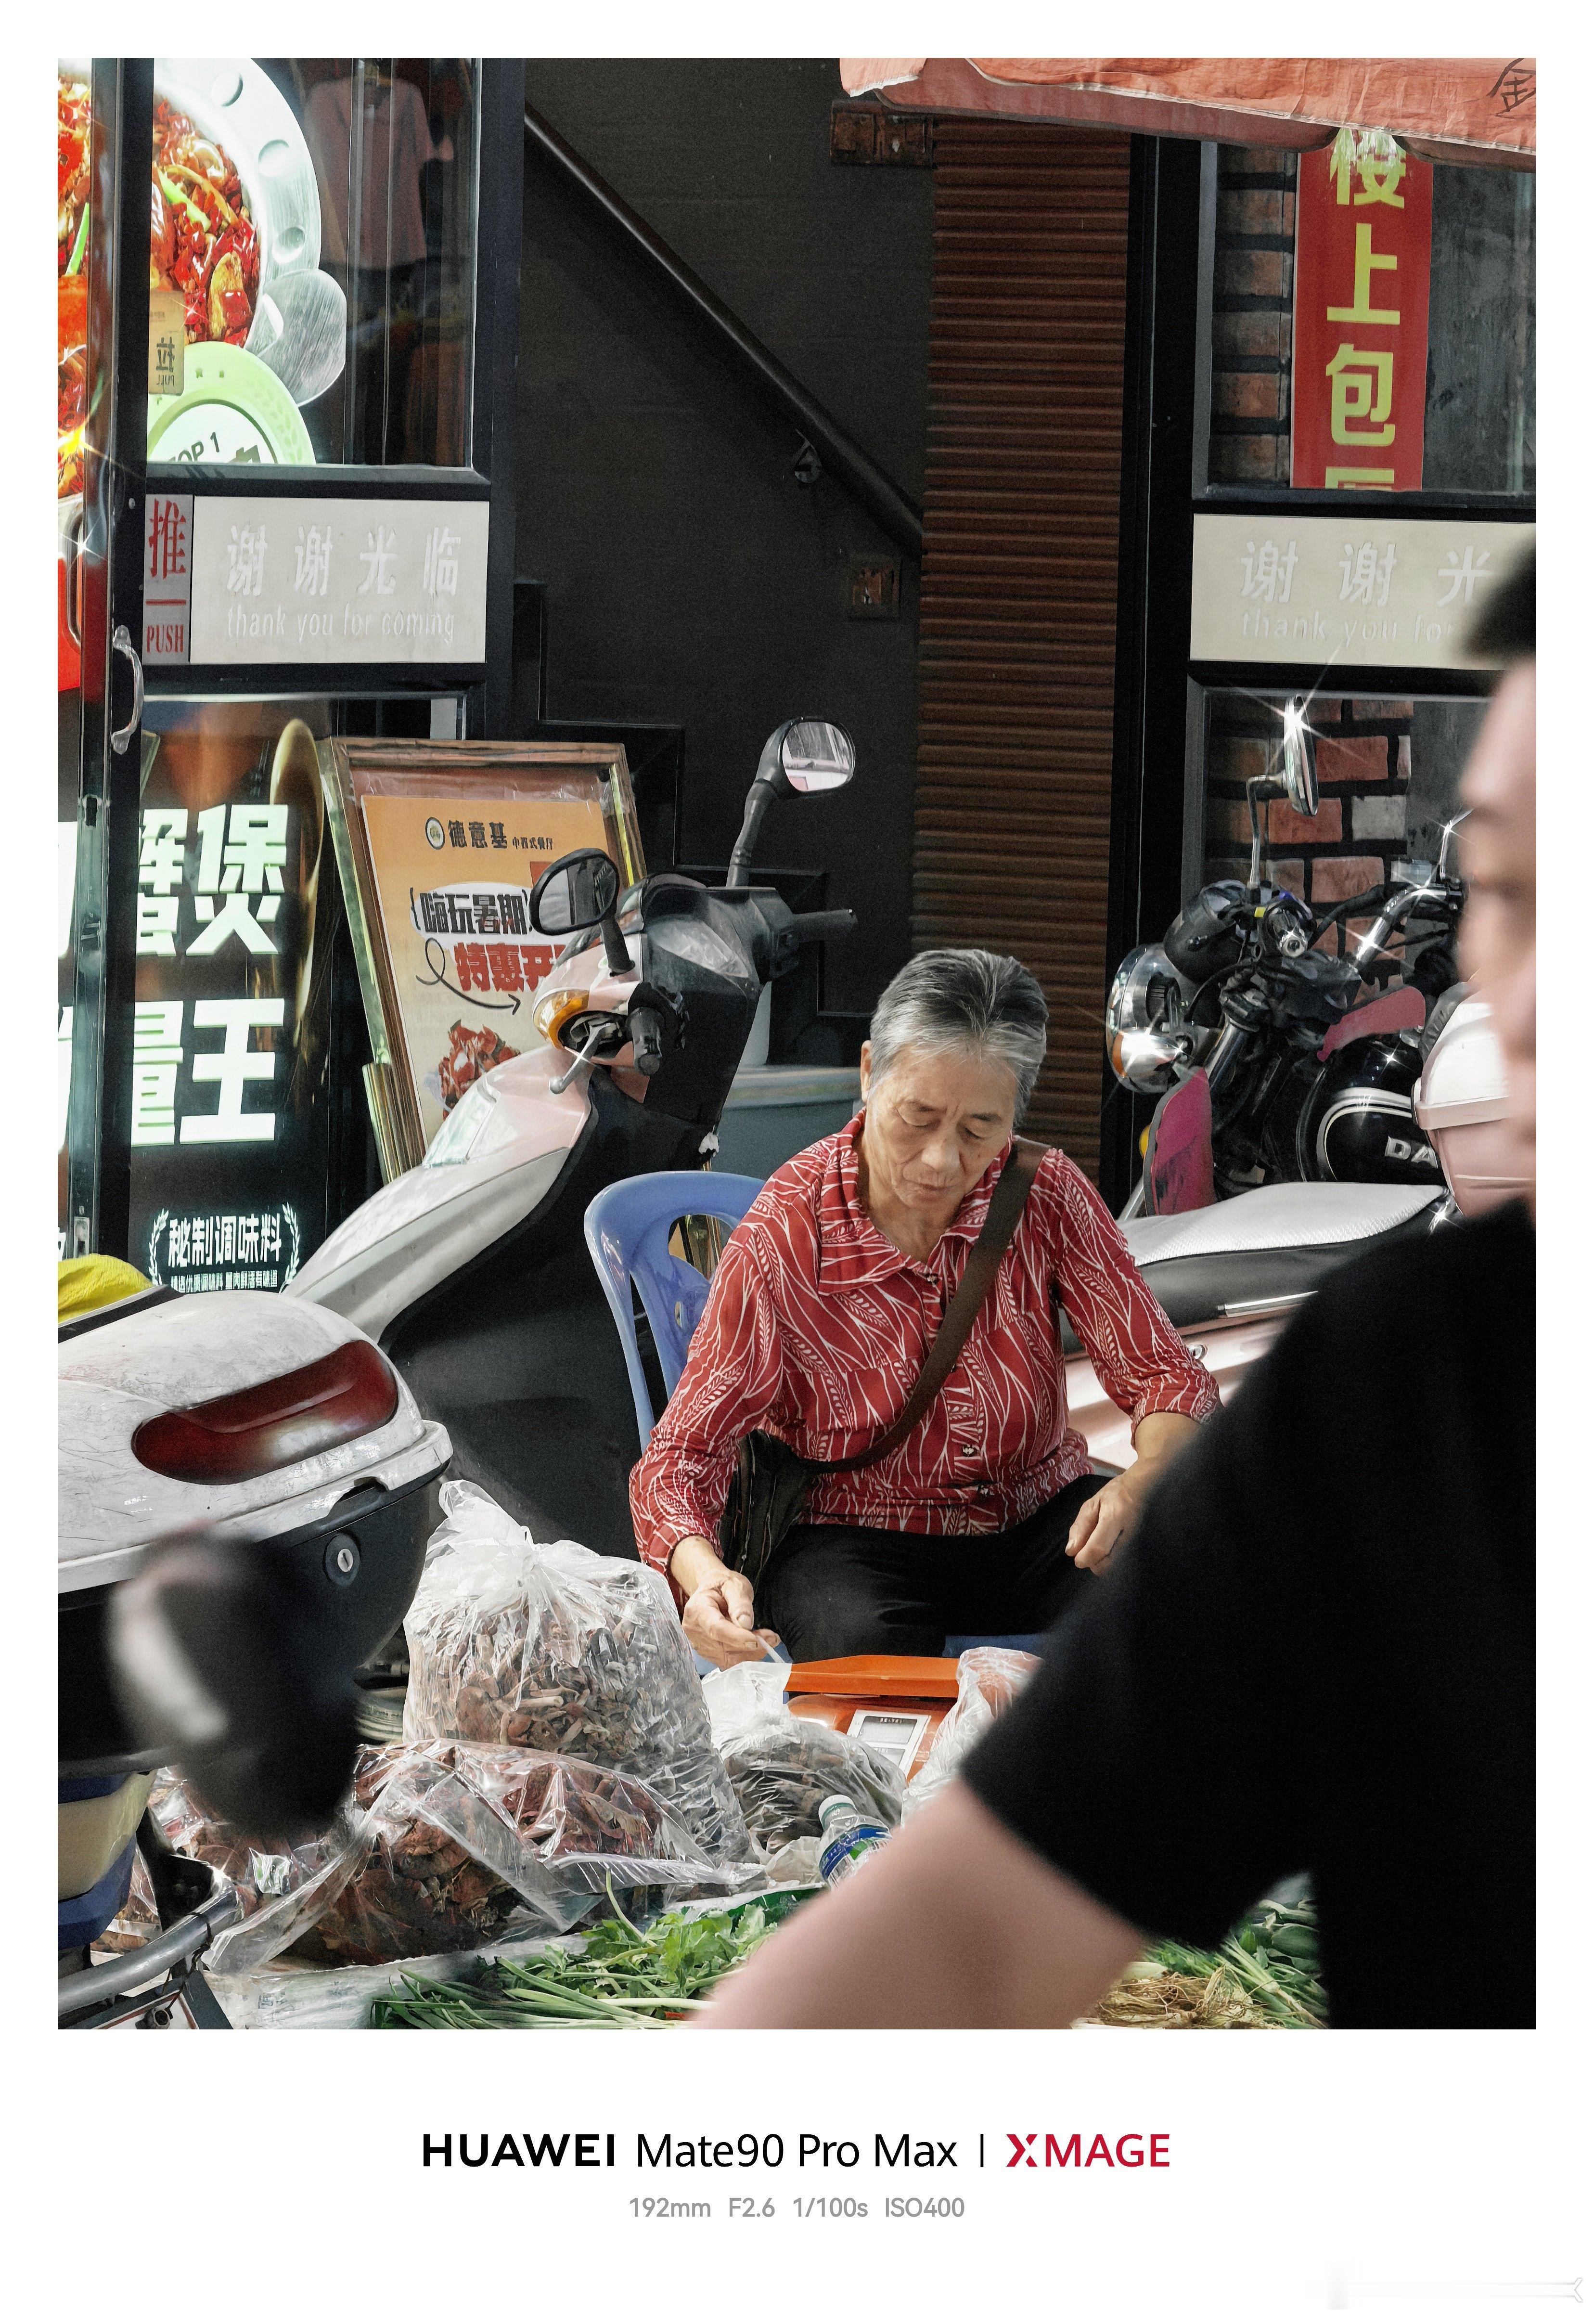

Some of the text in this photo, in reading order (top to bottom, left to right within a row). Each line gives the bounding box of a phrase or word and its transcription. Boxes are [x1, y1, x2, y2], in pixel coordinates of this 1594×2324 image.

[1324, 128, 1406, 490] 楼上包
[210, 431, 220, 453] 1
[148, 498, 187, 580] 推
[226, 523, 462, 598] 谢谢光临
[146, 624, 185, 654] PUSH
[227, 602, 455, 647] thank you for coming
[1242, 608, 1327, 641] thank
[1345, 620, 1397, 648] you
[448, 820, 507, 849] 德意基
[420, 891, 528, 935] 嗨玩暑期
[453, 942, 567, 993] 特惠开
[168, 1213, 282, 1268] 秘制调味料
